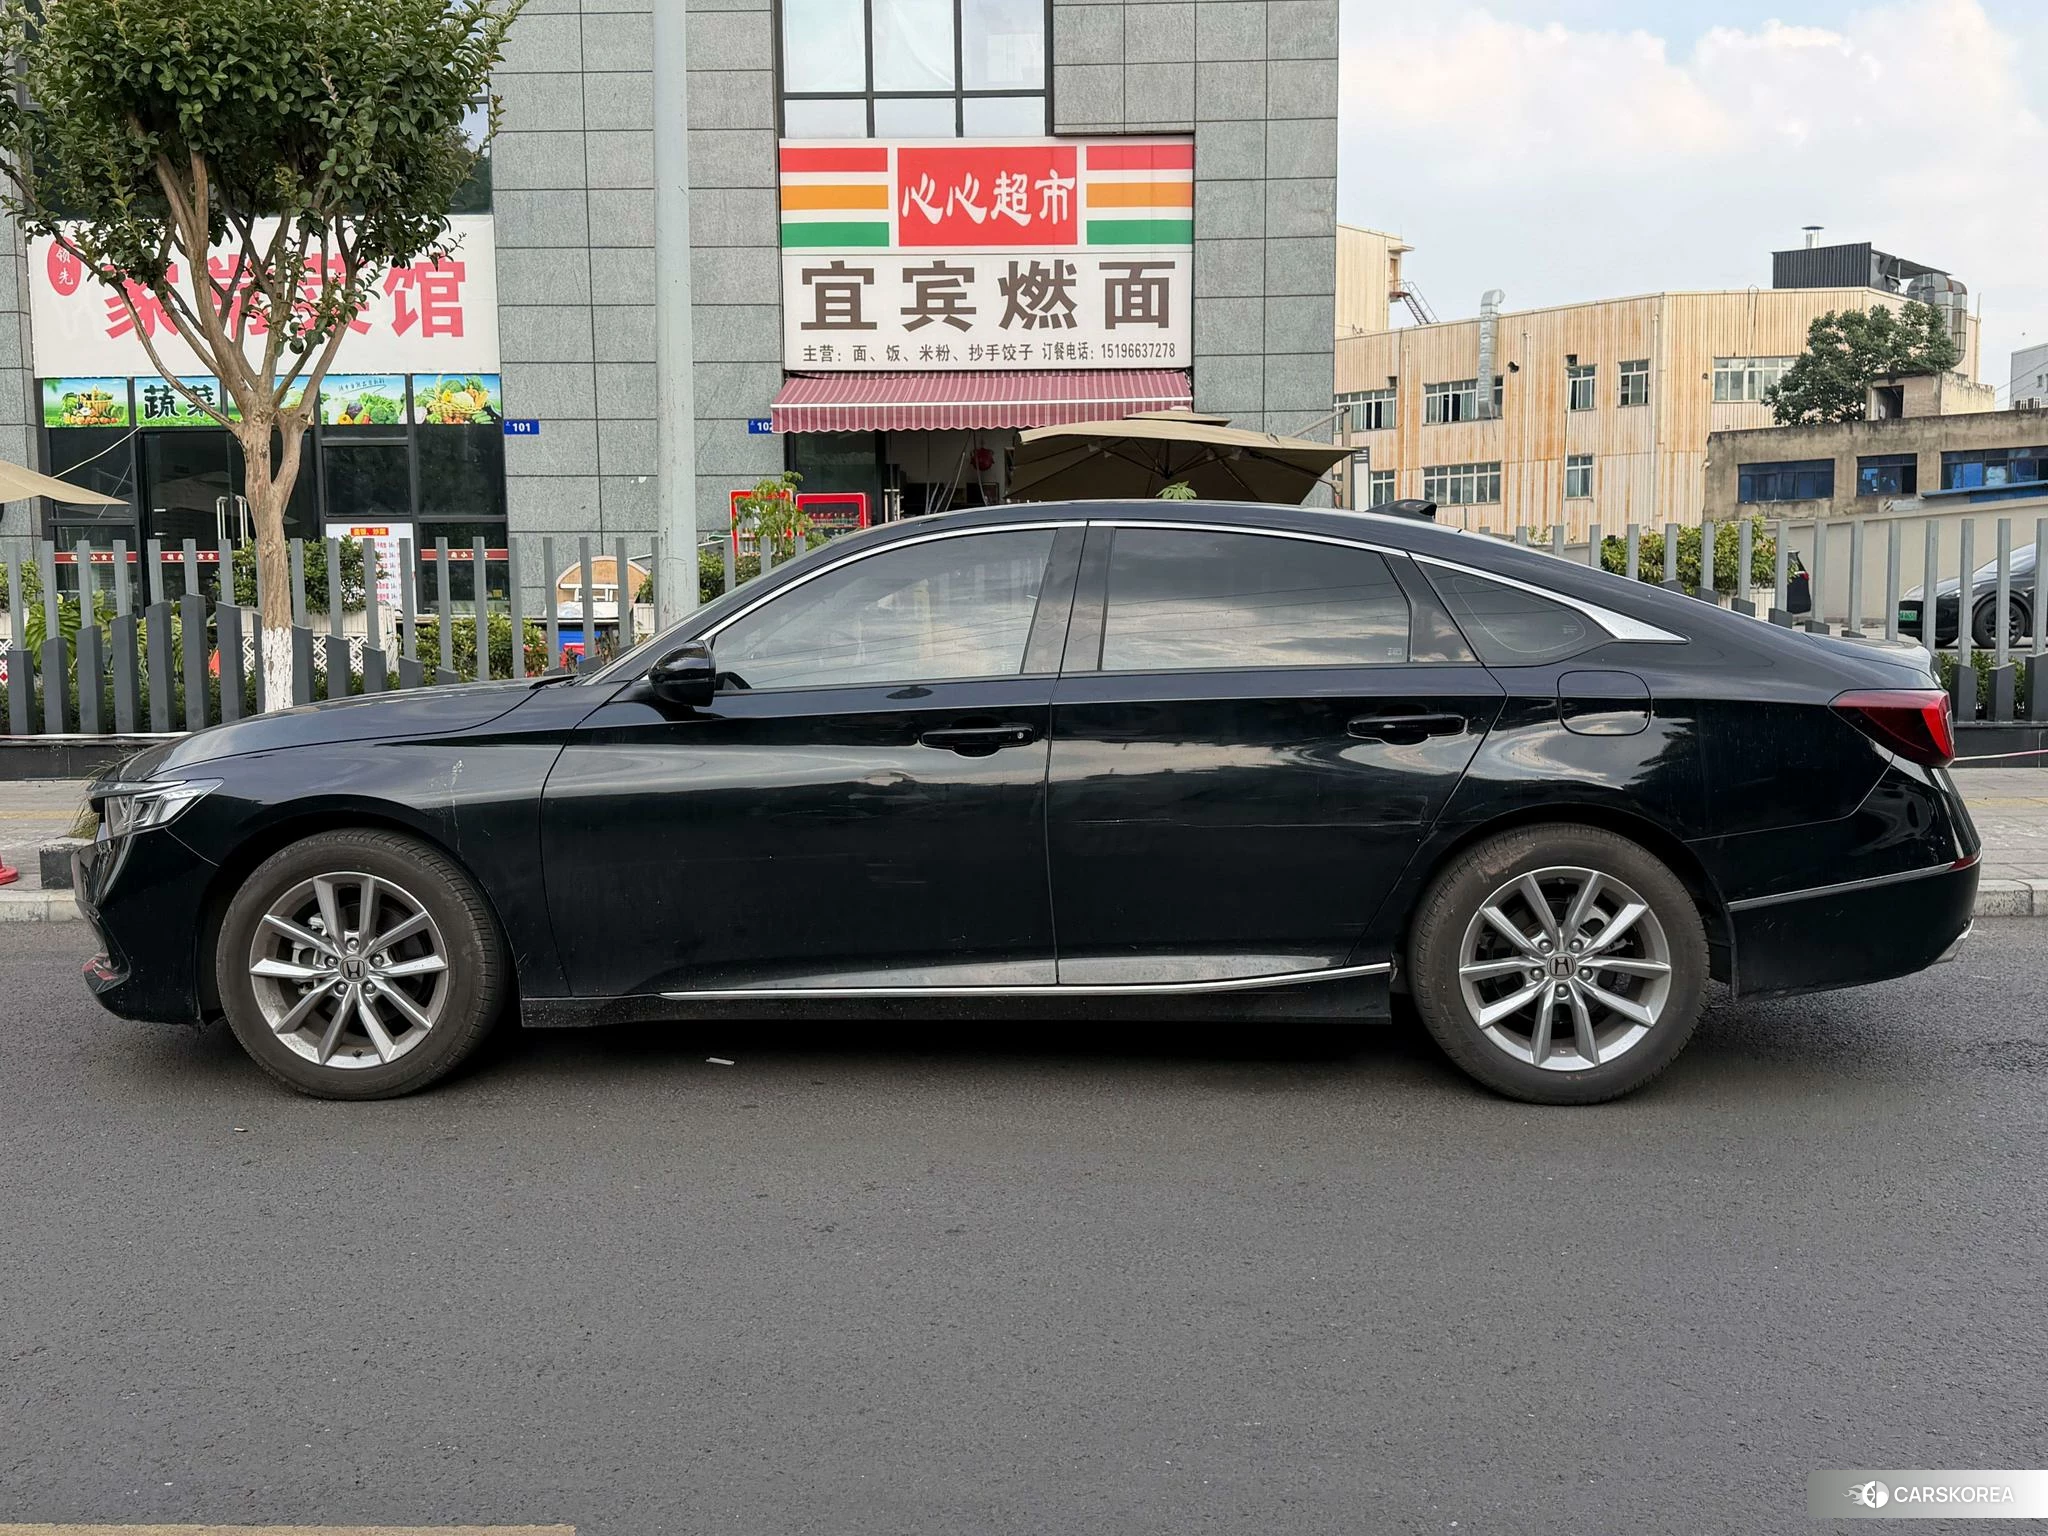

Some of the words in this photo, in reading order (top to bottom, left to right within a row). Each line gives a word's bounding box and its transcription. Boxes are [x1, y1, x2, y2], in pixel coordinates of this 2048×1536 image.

[901, 169, 1076, 227] 心心超市
[800, 259, 1176, 333] 宜宾燃面
[143, 384, 216, 419] 蔬菜
[512, 422, 531, 432] 101
